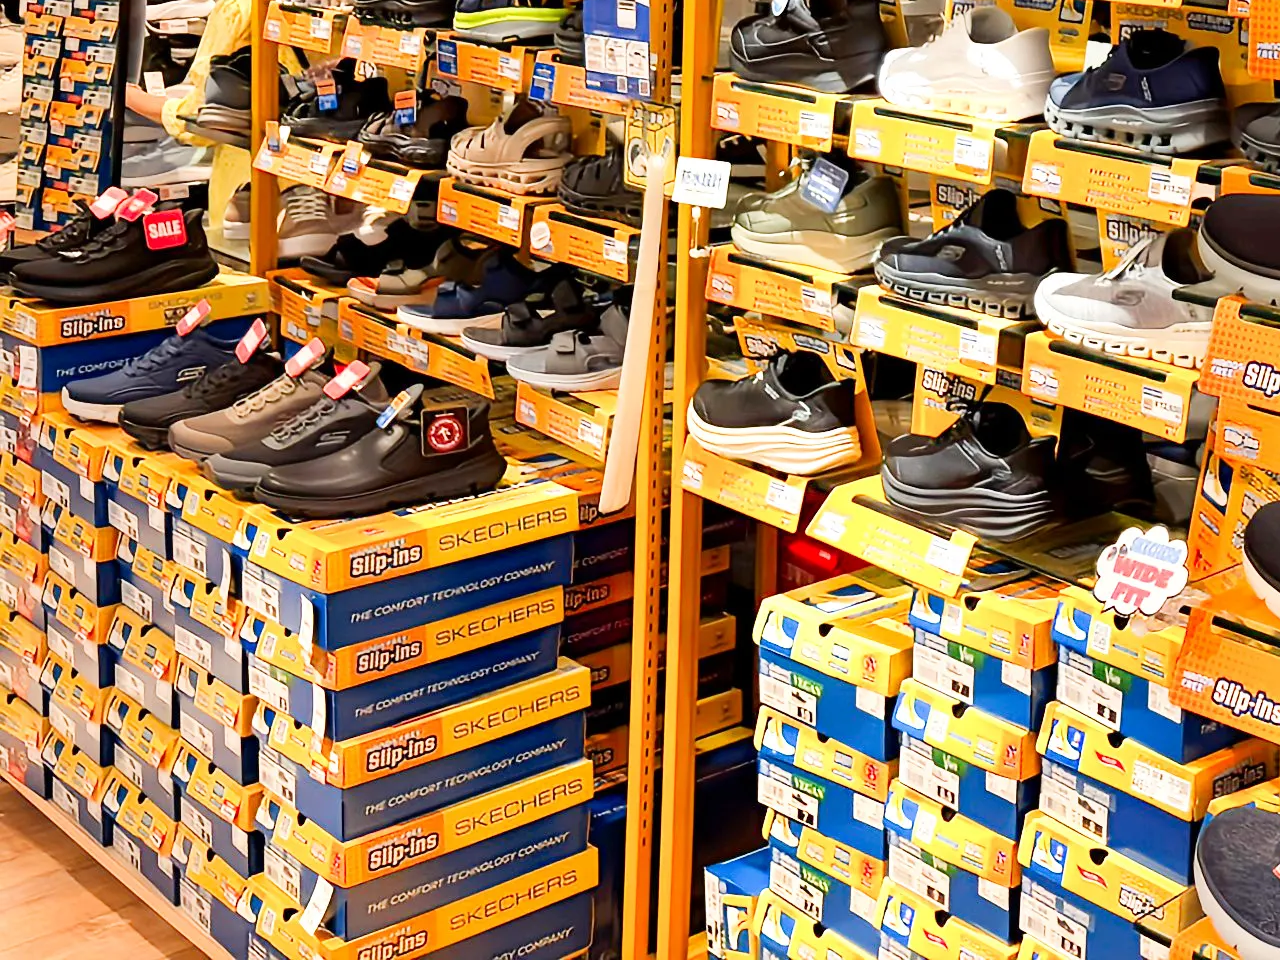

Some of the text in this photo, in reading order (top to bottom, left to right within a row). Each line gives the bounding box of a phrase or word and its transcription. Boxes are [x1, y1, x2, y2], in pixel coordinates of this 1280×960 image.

[148, 219, 182, 239] SALE
[61, 314, 126, 338] Slip-ins
[350, 506, 568, 579] Slip-ins SKECHERS
[1112, 553, 1175, 589] WIDE
[351, 611, 372, 624] THE
[504, 560, 556, 582] COMPANY
[1109, 582, 1151, 608] FIT
[356, 598, 556, 675] Slip-ins SKECHERS
[355, 705, 374, 718] THE
[367, 686, 581, 774] Slip-ins SKECHERS
[366, 801, 386, 816] THE
[515, 739, 568, 762] COMPANY
[369, 779, 583, 871] Slip-ins SKECHERS
[368, 831, 570, 915] THE COMFORT TECHNOLOGY COMPANY
[449, 870, 578, 931] SKECHERS
